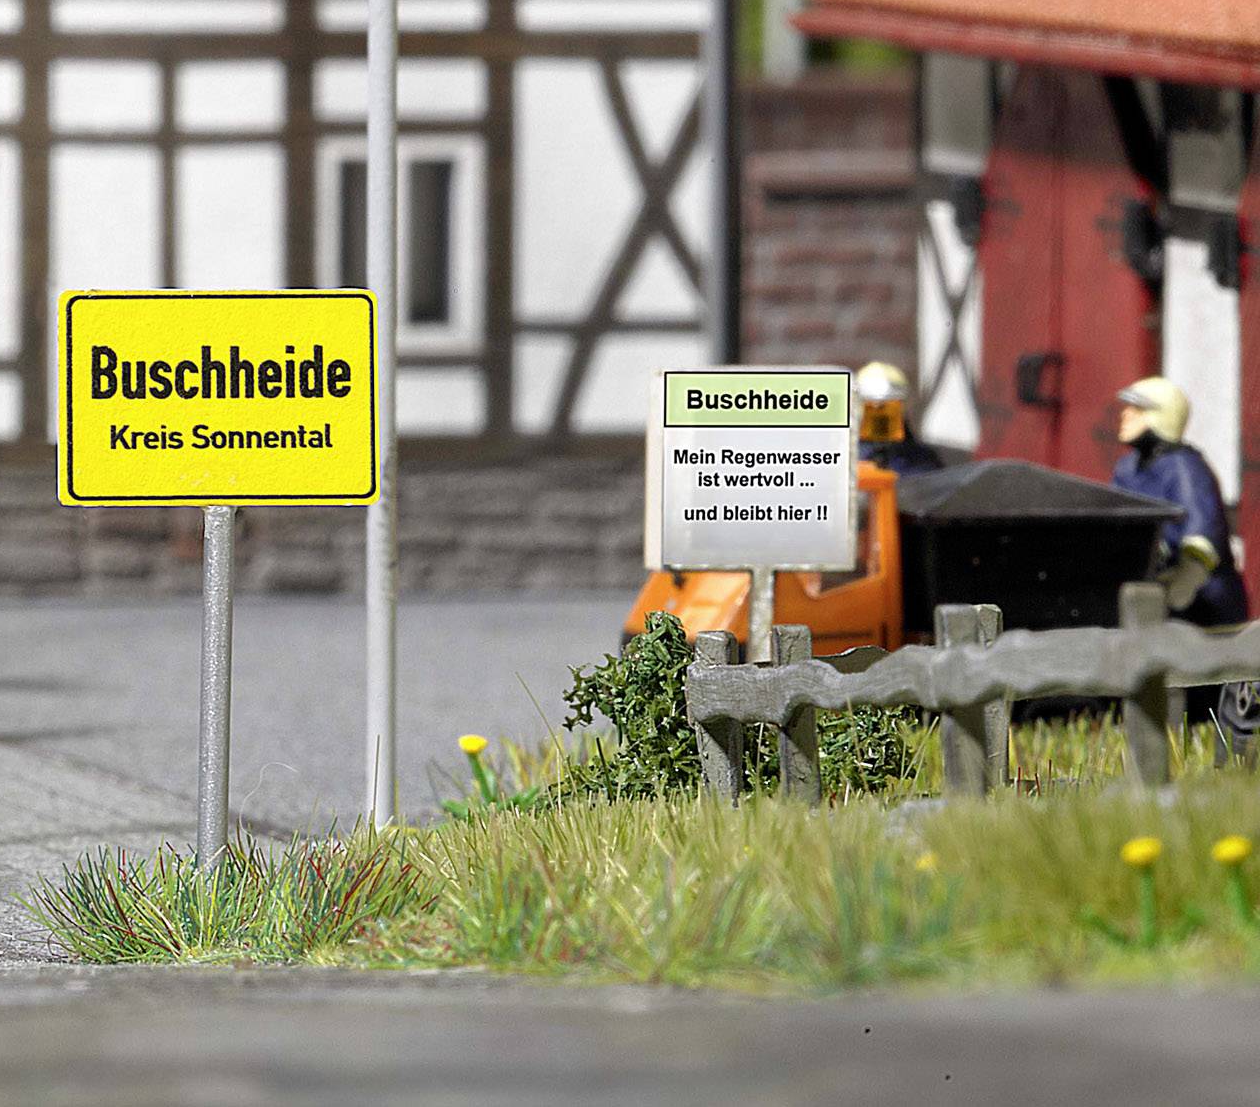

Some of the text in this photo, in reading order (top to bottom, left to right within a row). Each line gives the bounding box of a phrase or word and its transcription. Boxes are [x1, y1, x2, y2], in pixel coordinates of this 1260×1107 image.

[91, 345, 351, 399] Buschheide
[686, 389, 829, 410] Buschheide
[110, 423, 333, 449] Kreis Sonnental
[673, 449, 841, 468] Mein Regenwasser
[698, 472, 720, 487] ist
[724, 472, 794, 487] wertvoll
[684, 506, 828, 521] und bleibt hier !!
